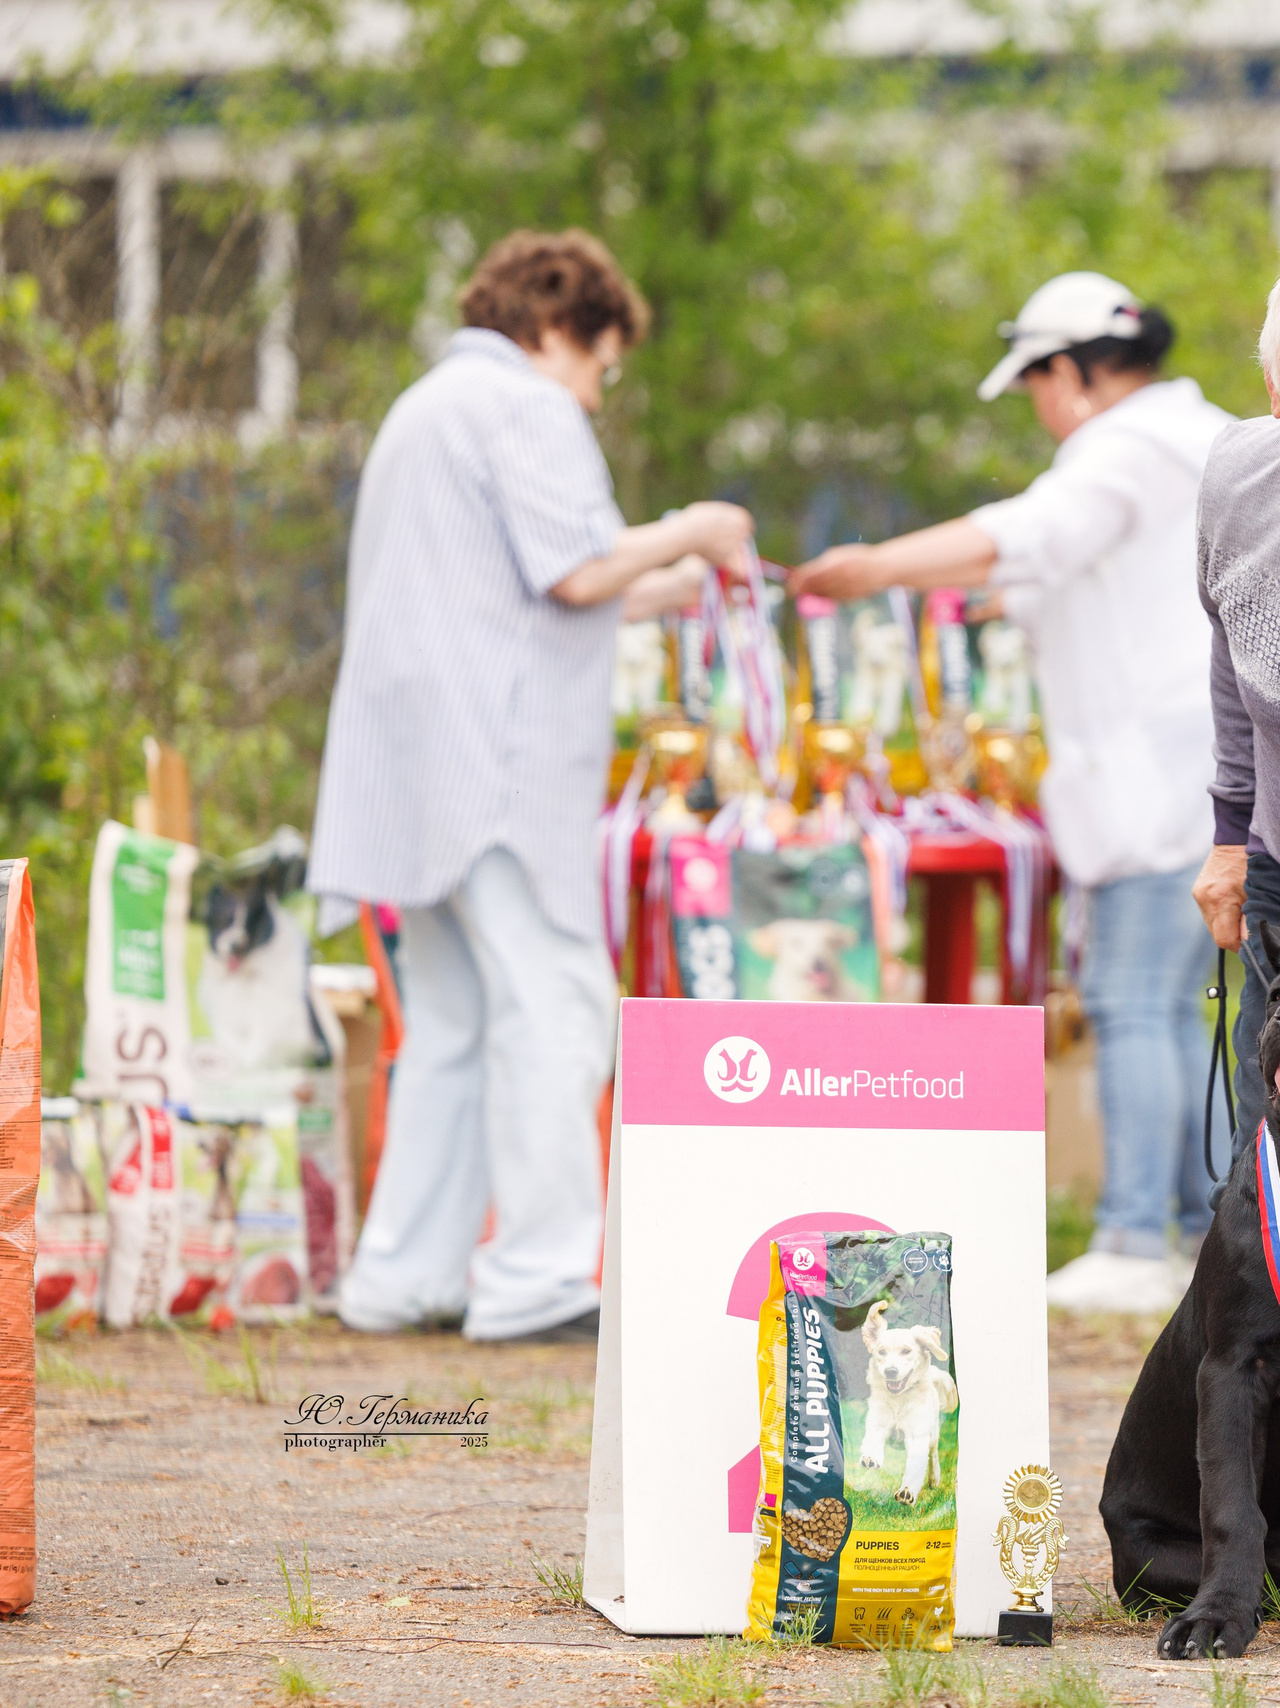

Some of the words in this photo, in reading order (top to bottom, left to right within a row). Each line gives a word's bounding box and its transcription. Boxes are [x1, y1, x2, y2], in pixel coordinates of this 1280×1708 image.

[780, 1068, 964, 1099] AllerPetfood
[802, 1306, 829, 1417] PUPPIES
[791, 1415, 799, 1463] Complete
[804, 1422, 830, 1474] ALL
[855, 1541, 900, 1550] PUPPIES
